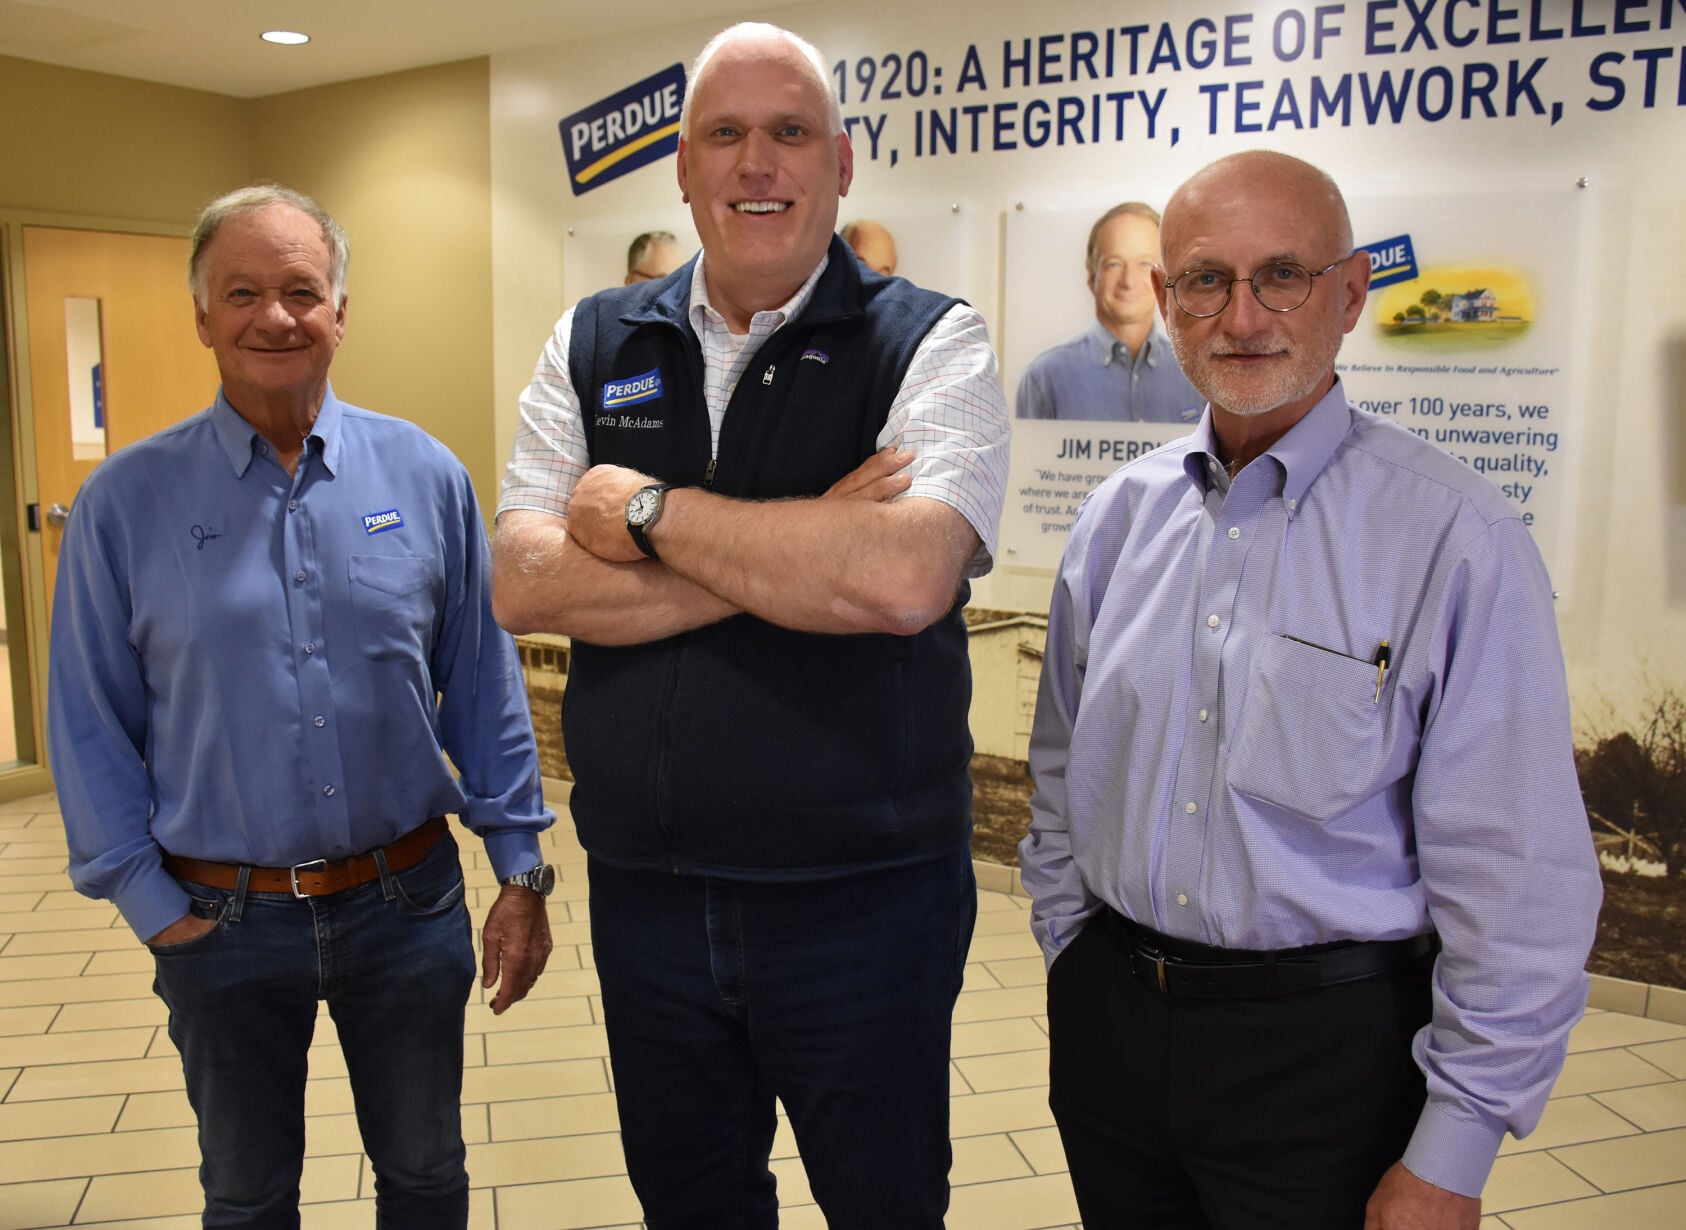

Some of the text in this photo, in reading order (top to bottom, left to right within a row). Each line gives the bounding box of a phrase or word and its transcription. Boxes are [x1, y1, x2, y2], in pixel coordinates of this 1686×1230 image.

[832, 51, 943, 105] 1920:
[955, 45, 988, 92] A
[1002, 13, 1254, 90] HERITAGE
[1272, 4, 1346, 62] OF
[914, 88, 1180, 158] INTEGRITY,
[1199, 57, 1564, 135] TEAMWORK,
[1585, 46, 1686, 112] ST
[570, 82, 680, 161] PERDUE
[1369, 244, 1406, 271] DUE
[1351, 364, 1382, 373] Believe
[1396, 364, 1450, 374] Responsible
[1453, 365, 1477, 374] Food
[1478, 366, 1498, 374] and
[606, 375, 655, 398] PERDUE
[1359, 397, 1550, 421] over 100 years, we
[618, 415, 665, 429] McAdams
[1057, 438, 1092, 459] JIM
[1435, 426, 1559, 452] unwavering
[1058, 471, 1083, 482] have
[1473, 453, 1548, 478] quality,
[1019, 486, 1052, 498] where
[1054, 489, 1070, 499] we
[1501, 481, 1533, 504] sty
[364, 511, 399, 528] PERDUE
[1022, 503, 1034, 513] of
[1041, 522, 1074, 534] growt
